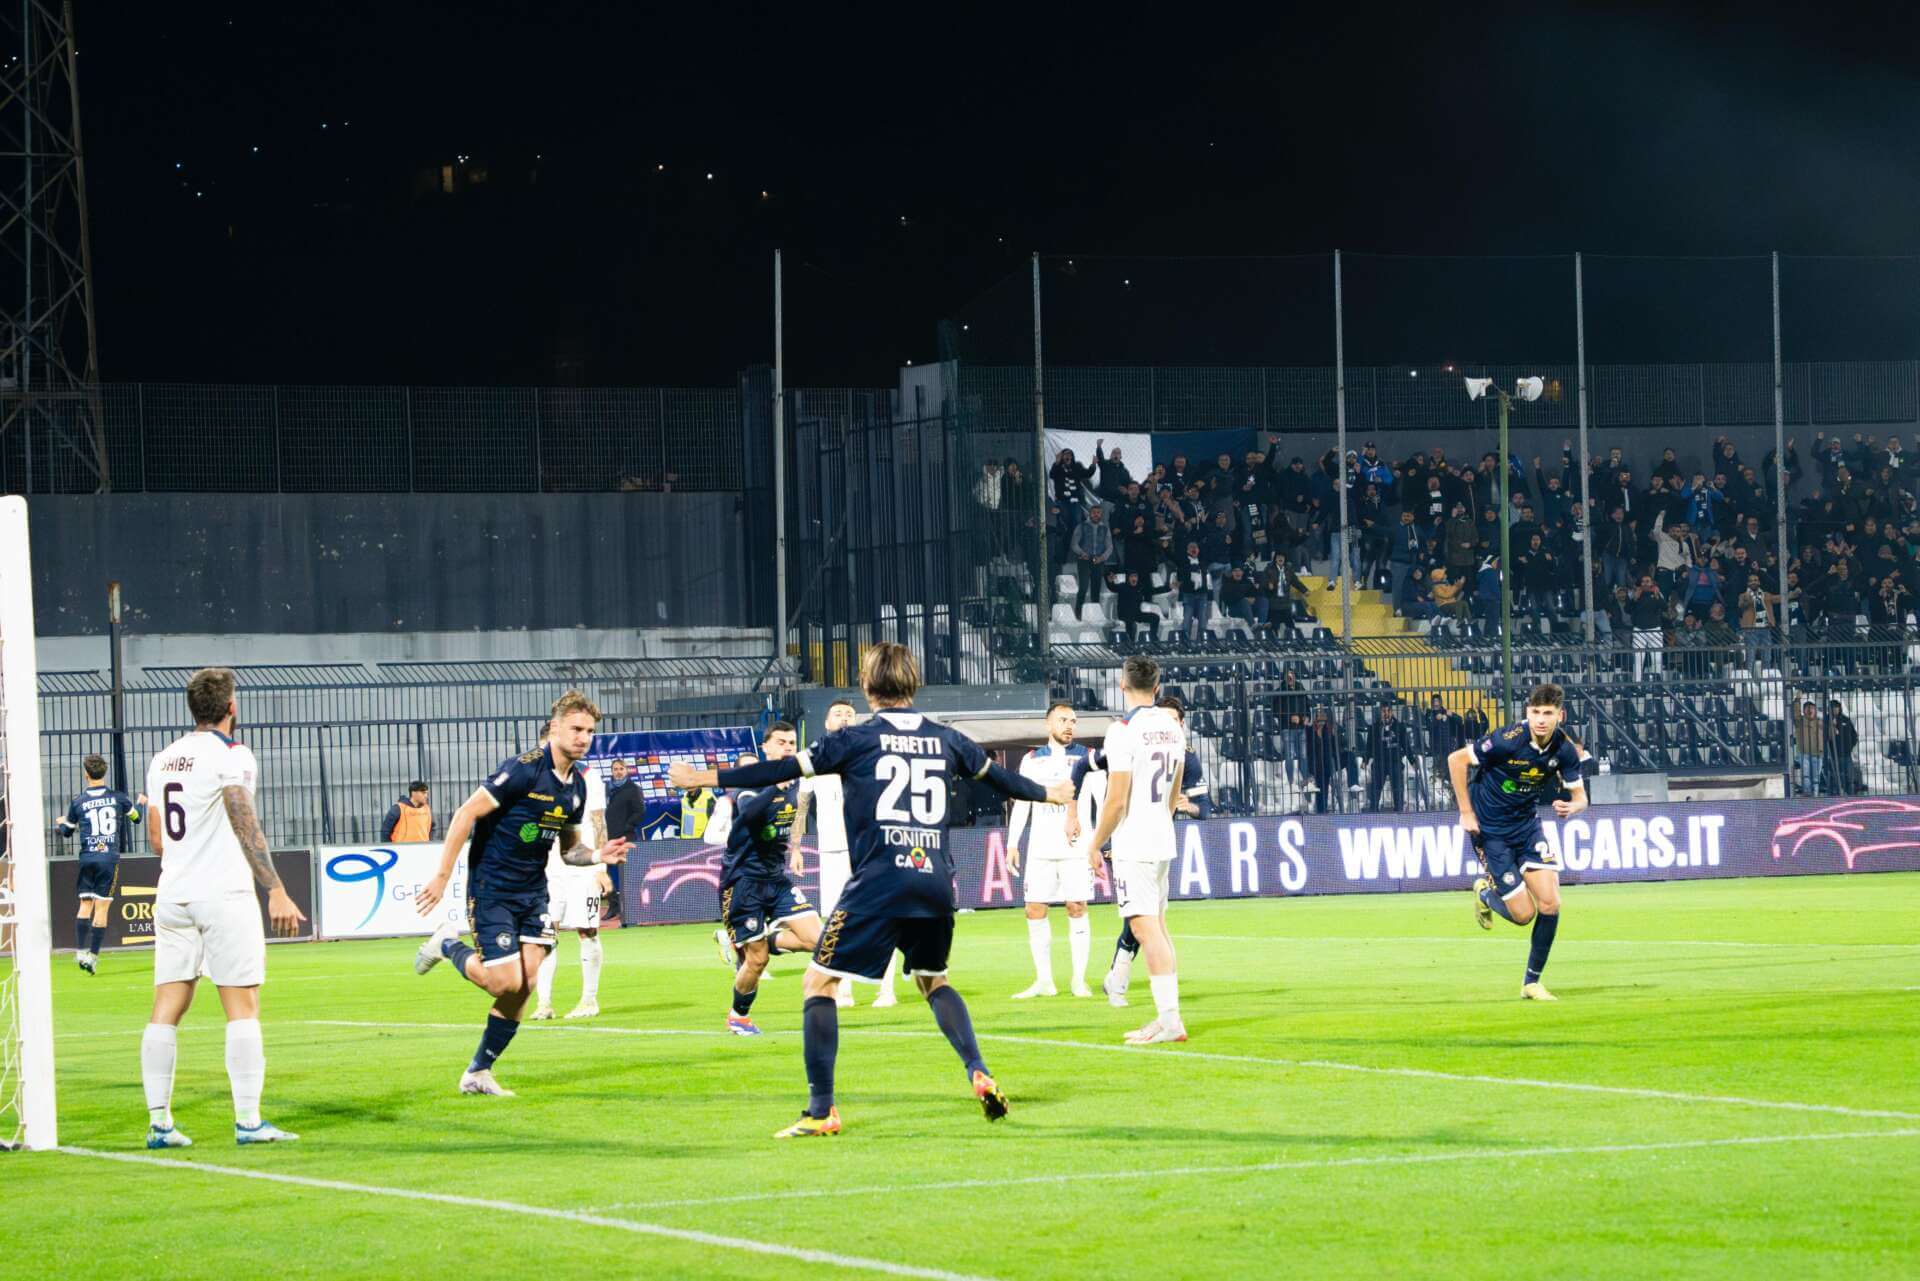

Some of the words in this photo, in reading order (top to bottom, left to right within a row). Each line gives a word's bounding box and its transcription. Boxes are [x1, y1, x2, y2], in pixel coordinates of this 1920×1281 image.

[879, 733, 942, 755] PERETTI
[875, 754, 947, 825] 25
[1150, 751, 1178, 803] 24
[85, 806, 117, 836] 16
[163, 782, 186, 842] 6
[1337, 814, 1725, 881] WWW.ACARS.IT
[586, 896, 600, 913] 99
[129, 921, 155, 933] L'AR
